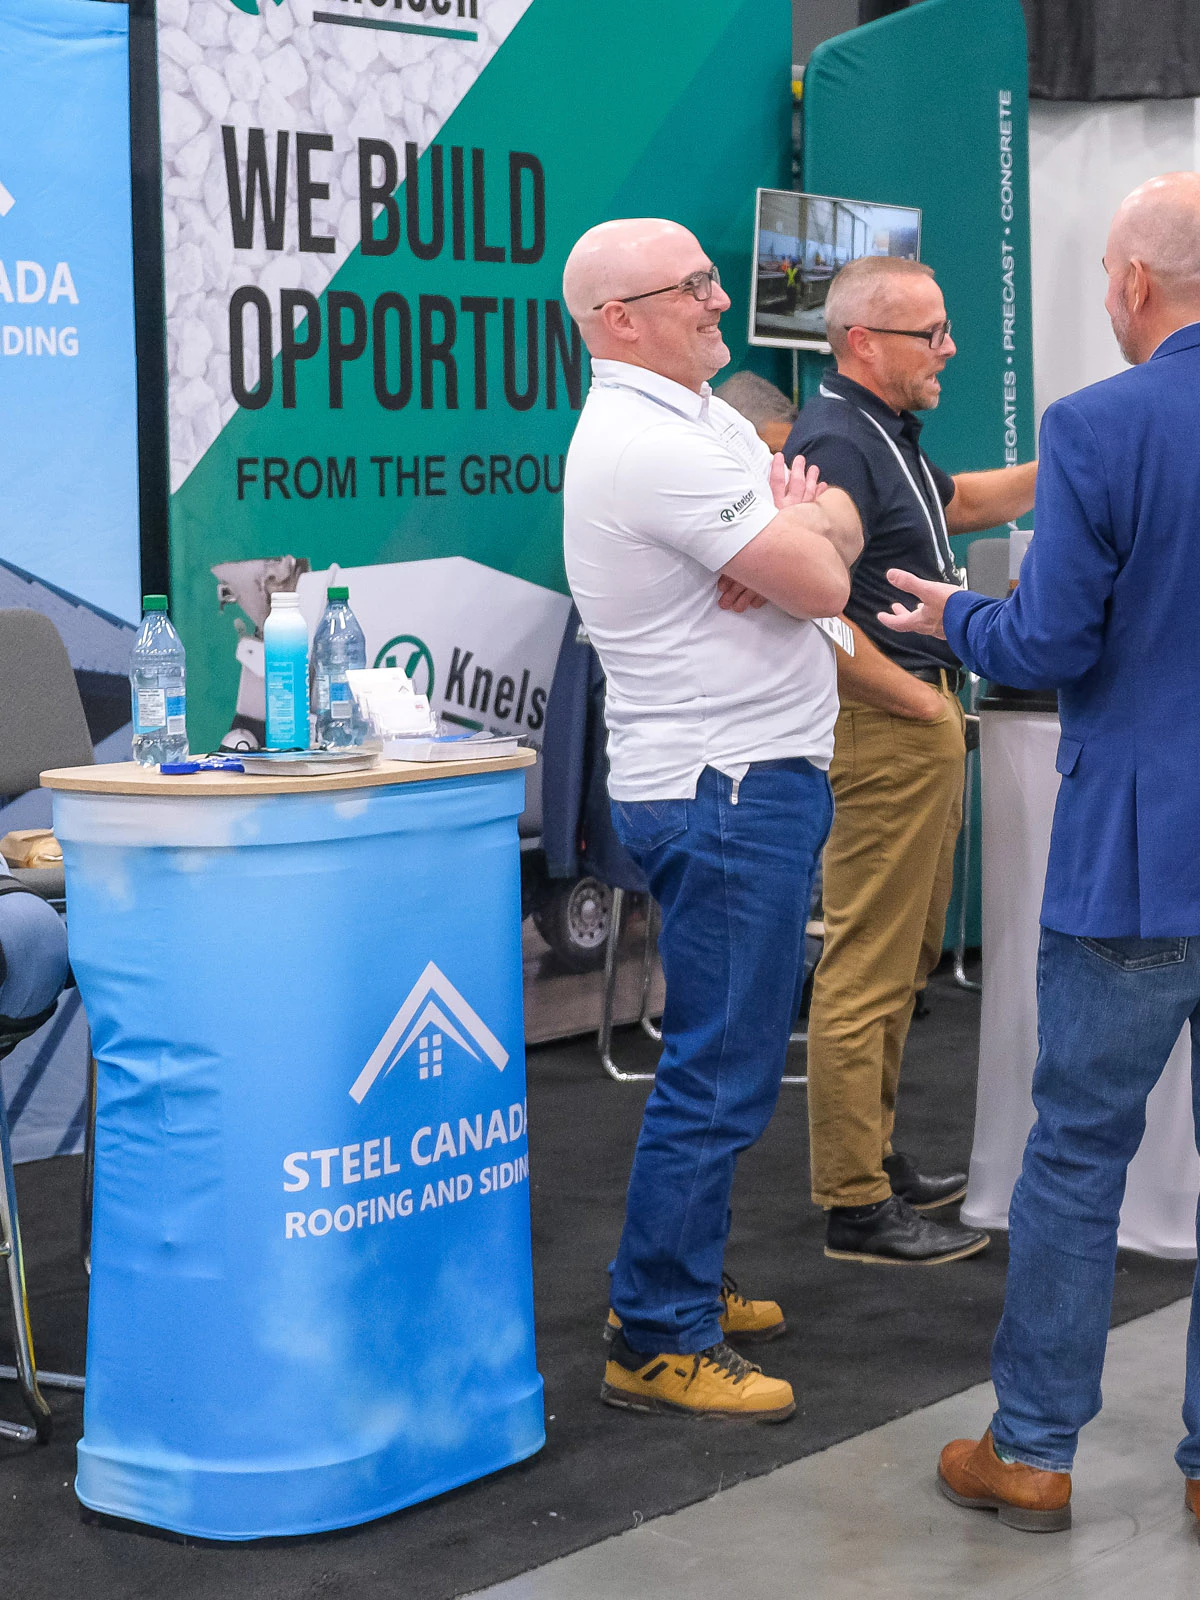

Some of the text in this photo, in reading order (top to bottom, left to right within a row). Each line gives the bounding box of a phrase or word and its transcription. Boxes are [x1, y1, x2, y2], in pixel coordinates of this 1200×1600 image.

[221, 125, 547, 264] WE BUILD
[999, 90, 1013, 223] CONCRETE
[1001, 240, 1015, 350] PRECAST
[228, 286, 592, 410] OPPORTUN
[236, 454, 564, 499] FROM THE GROU
[445, 646, 547, 730] Knels
[283, 1097, 527, 1192] STEEL CANAD
[285, 1151, 530, 1240] ROOFING AND SIDIN
